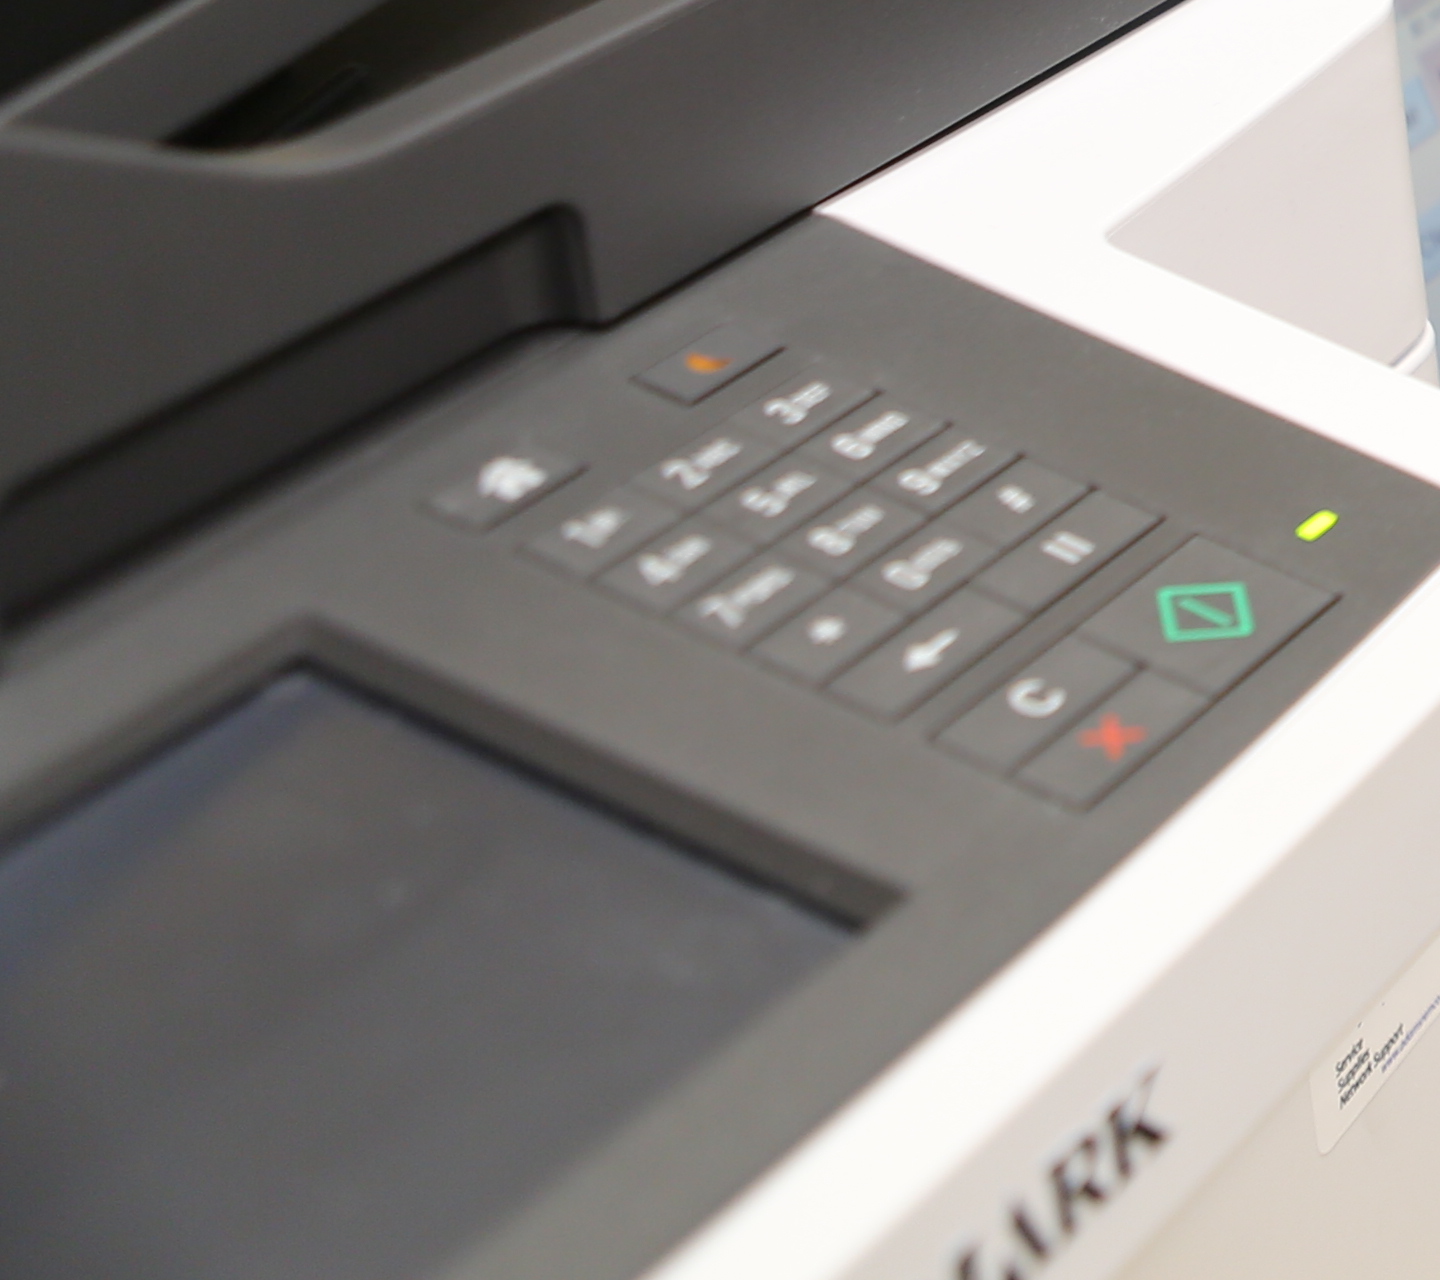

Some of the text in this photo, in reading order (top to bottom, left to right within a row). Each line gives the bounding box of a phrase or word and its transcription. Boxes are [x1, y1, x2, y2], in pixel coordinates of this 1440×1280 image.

[1335, 1037, 1364, 1079] Service
[1337, 1048, 1371, 1095] Supplies
[1339, 1022, 1404, 1111] Network Support
